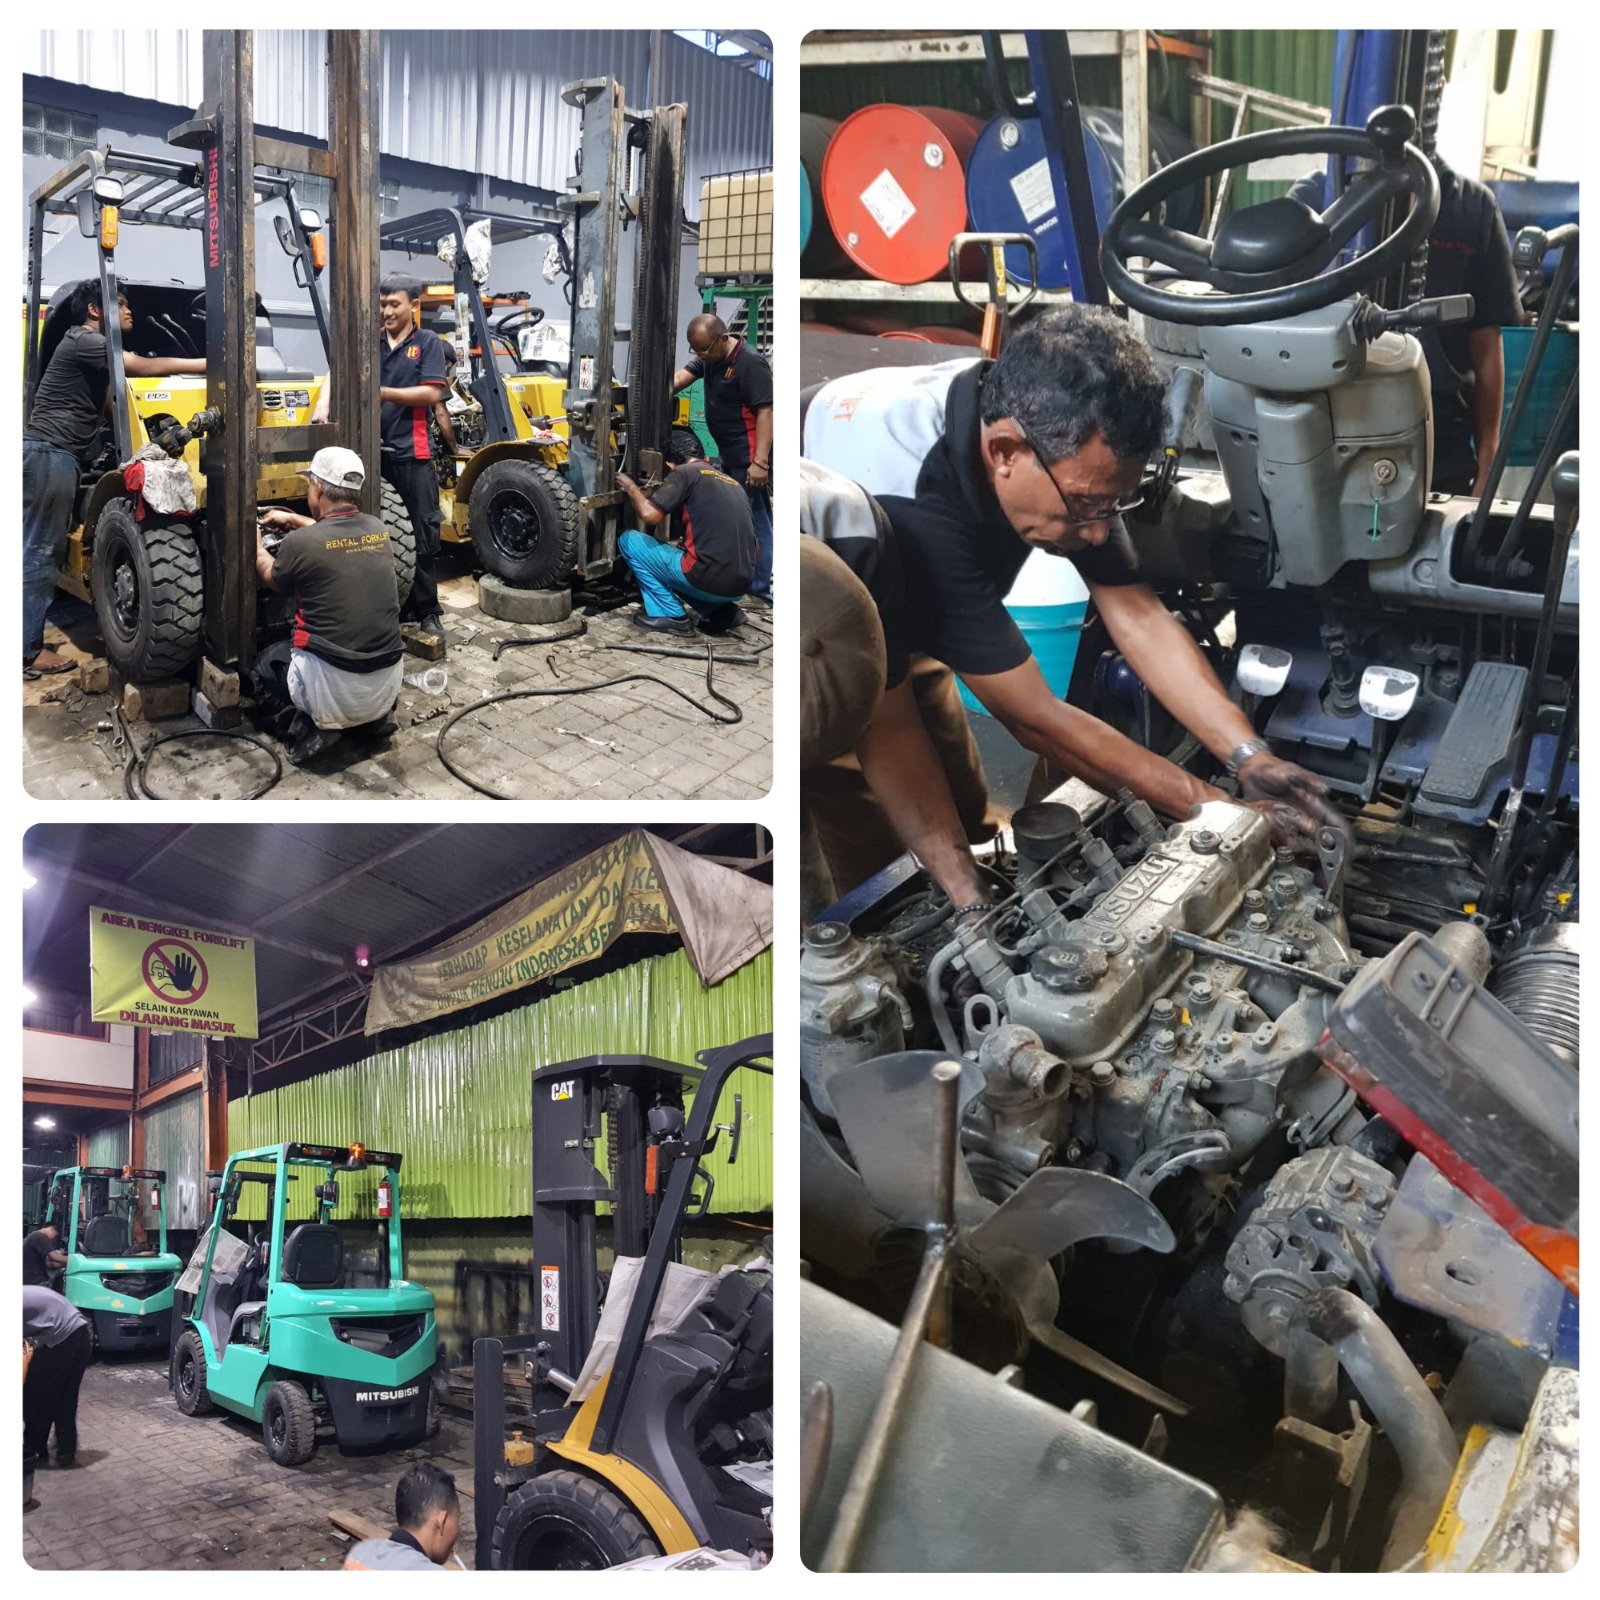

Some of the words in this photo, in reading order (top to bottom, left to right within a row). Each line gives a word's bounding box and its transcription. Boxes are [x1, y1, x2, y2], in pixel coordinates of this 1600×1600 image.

[208, 147, 219, 268] MITSUBISHI
[325, 538, 359, 550] RENTAL
[1090, 855, 1169, 922] ISUZU
[101, 912, 136, 930] AREA
[137, 919, 192, 941] BENGKEL
[194, 932, 247, 950] FORKLIFT
[437, 944, 488, 980] TERHADAP
[496, 896, 589, 958] KESELAMATAN
[600, 881, 622, 910] DA
[470, 964, 514, 999] MENUJU
[515, 933, 587, 982] INDONESIA
[119, 1010, 189, 1029] DILARANG
[191, 1019, 236, 1033] MASUK
[135, 1001, 168, 1013] SELAIN
[170, 1005, 219, 1019] KARYAWAN
[551, 1080, 575, 1101] CAT
[356, 1386, 420, 1402] MITSUBISHI
